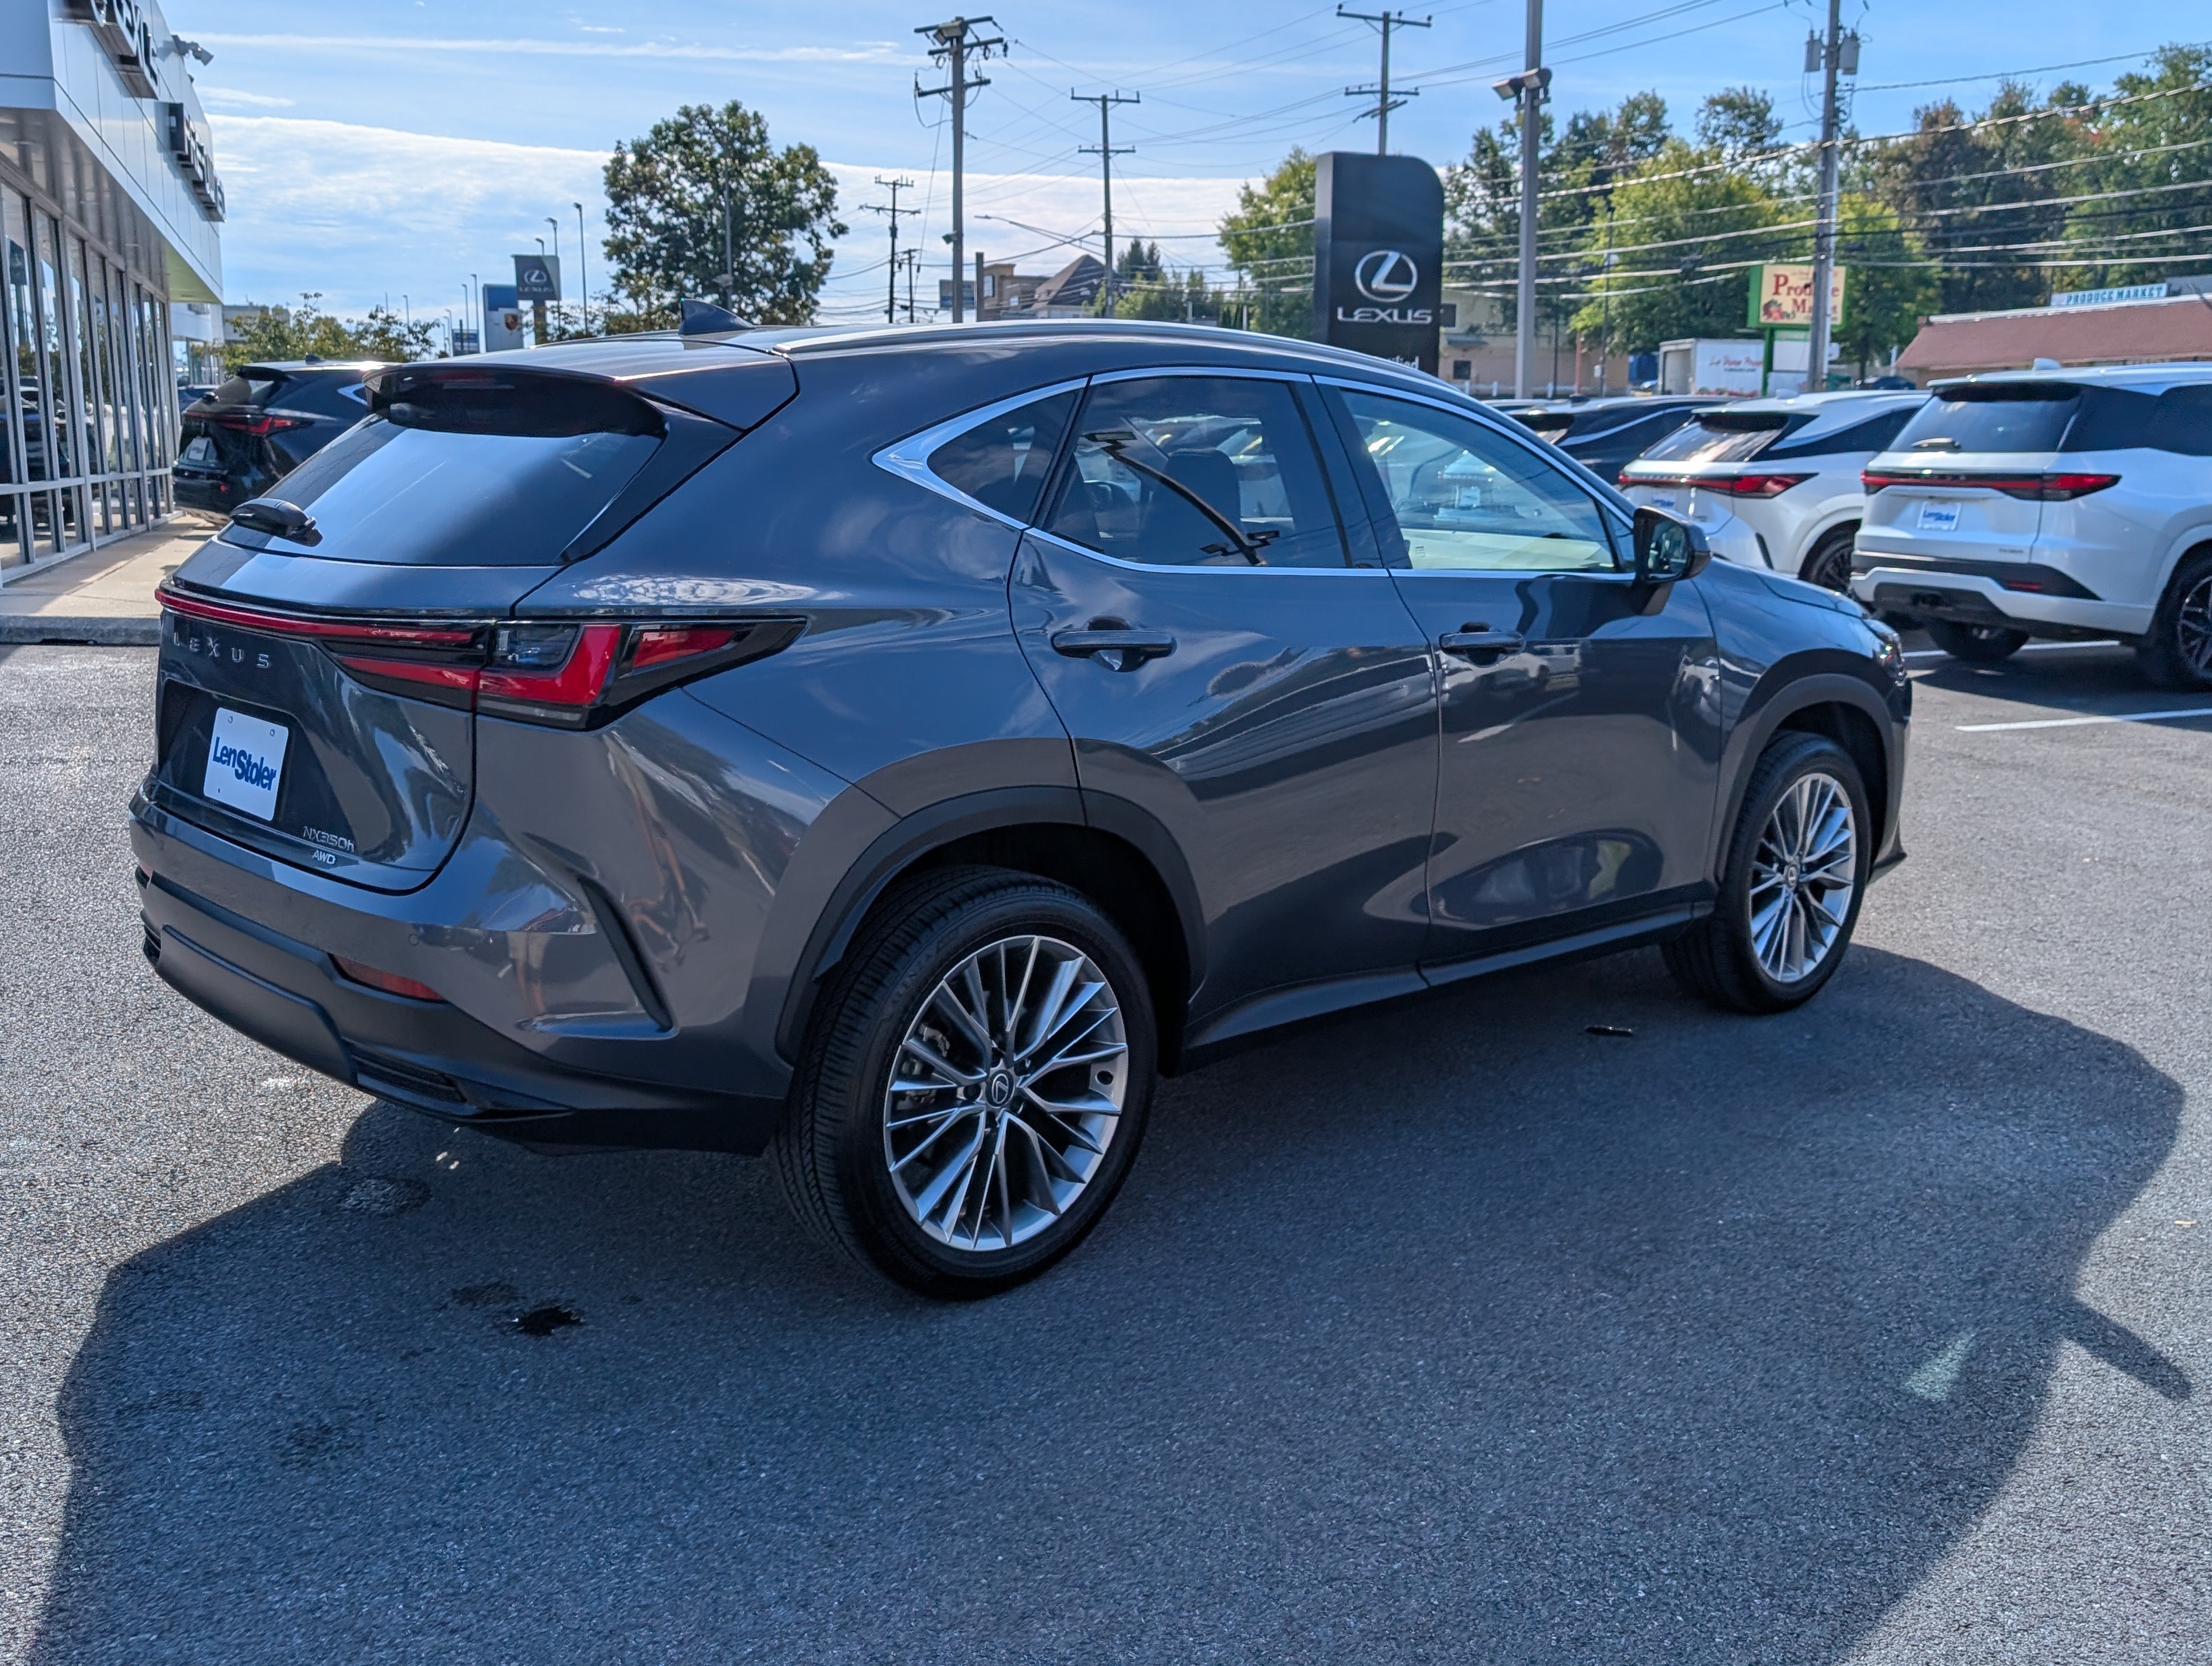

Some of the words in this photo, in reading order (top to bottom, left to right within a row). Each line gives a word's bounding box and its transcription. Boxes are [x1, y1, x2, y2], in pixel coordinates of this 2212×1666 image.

[2066, 290, 2113, 305] PRODUCE
[2117, 286, 2163, 299] MARKET
[1337, 306, 1433, 324] LEXUS
[173, 632, 269, 669] LEXUS
[303, 825, 355, 853] NX350h
[312, 849, 336, 864] AWD
